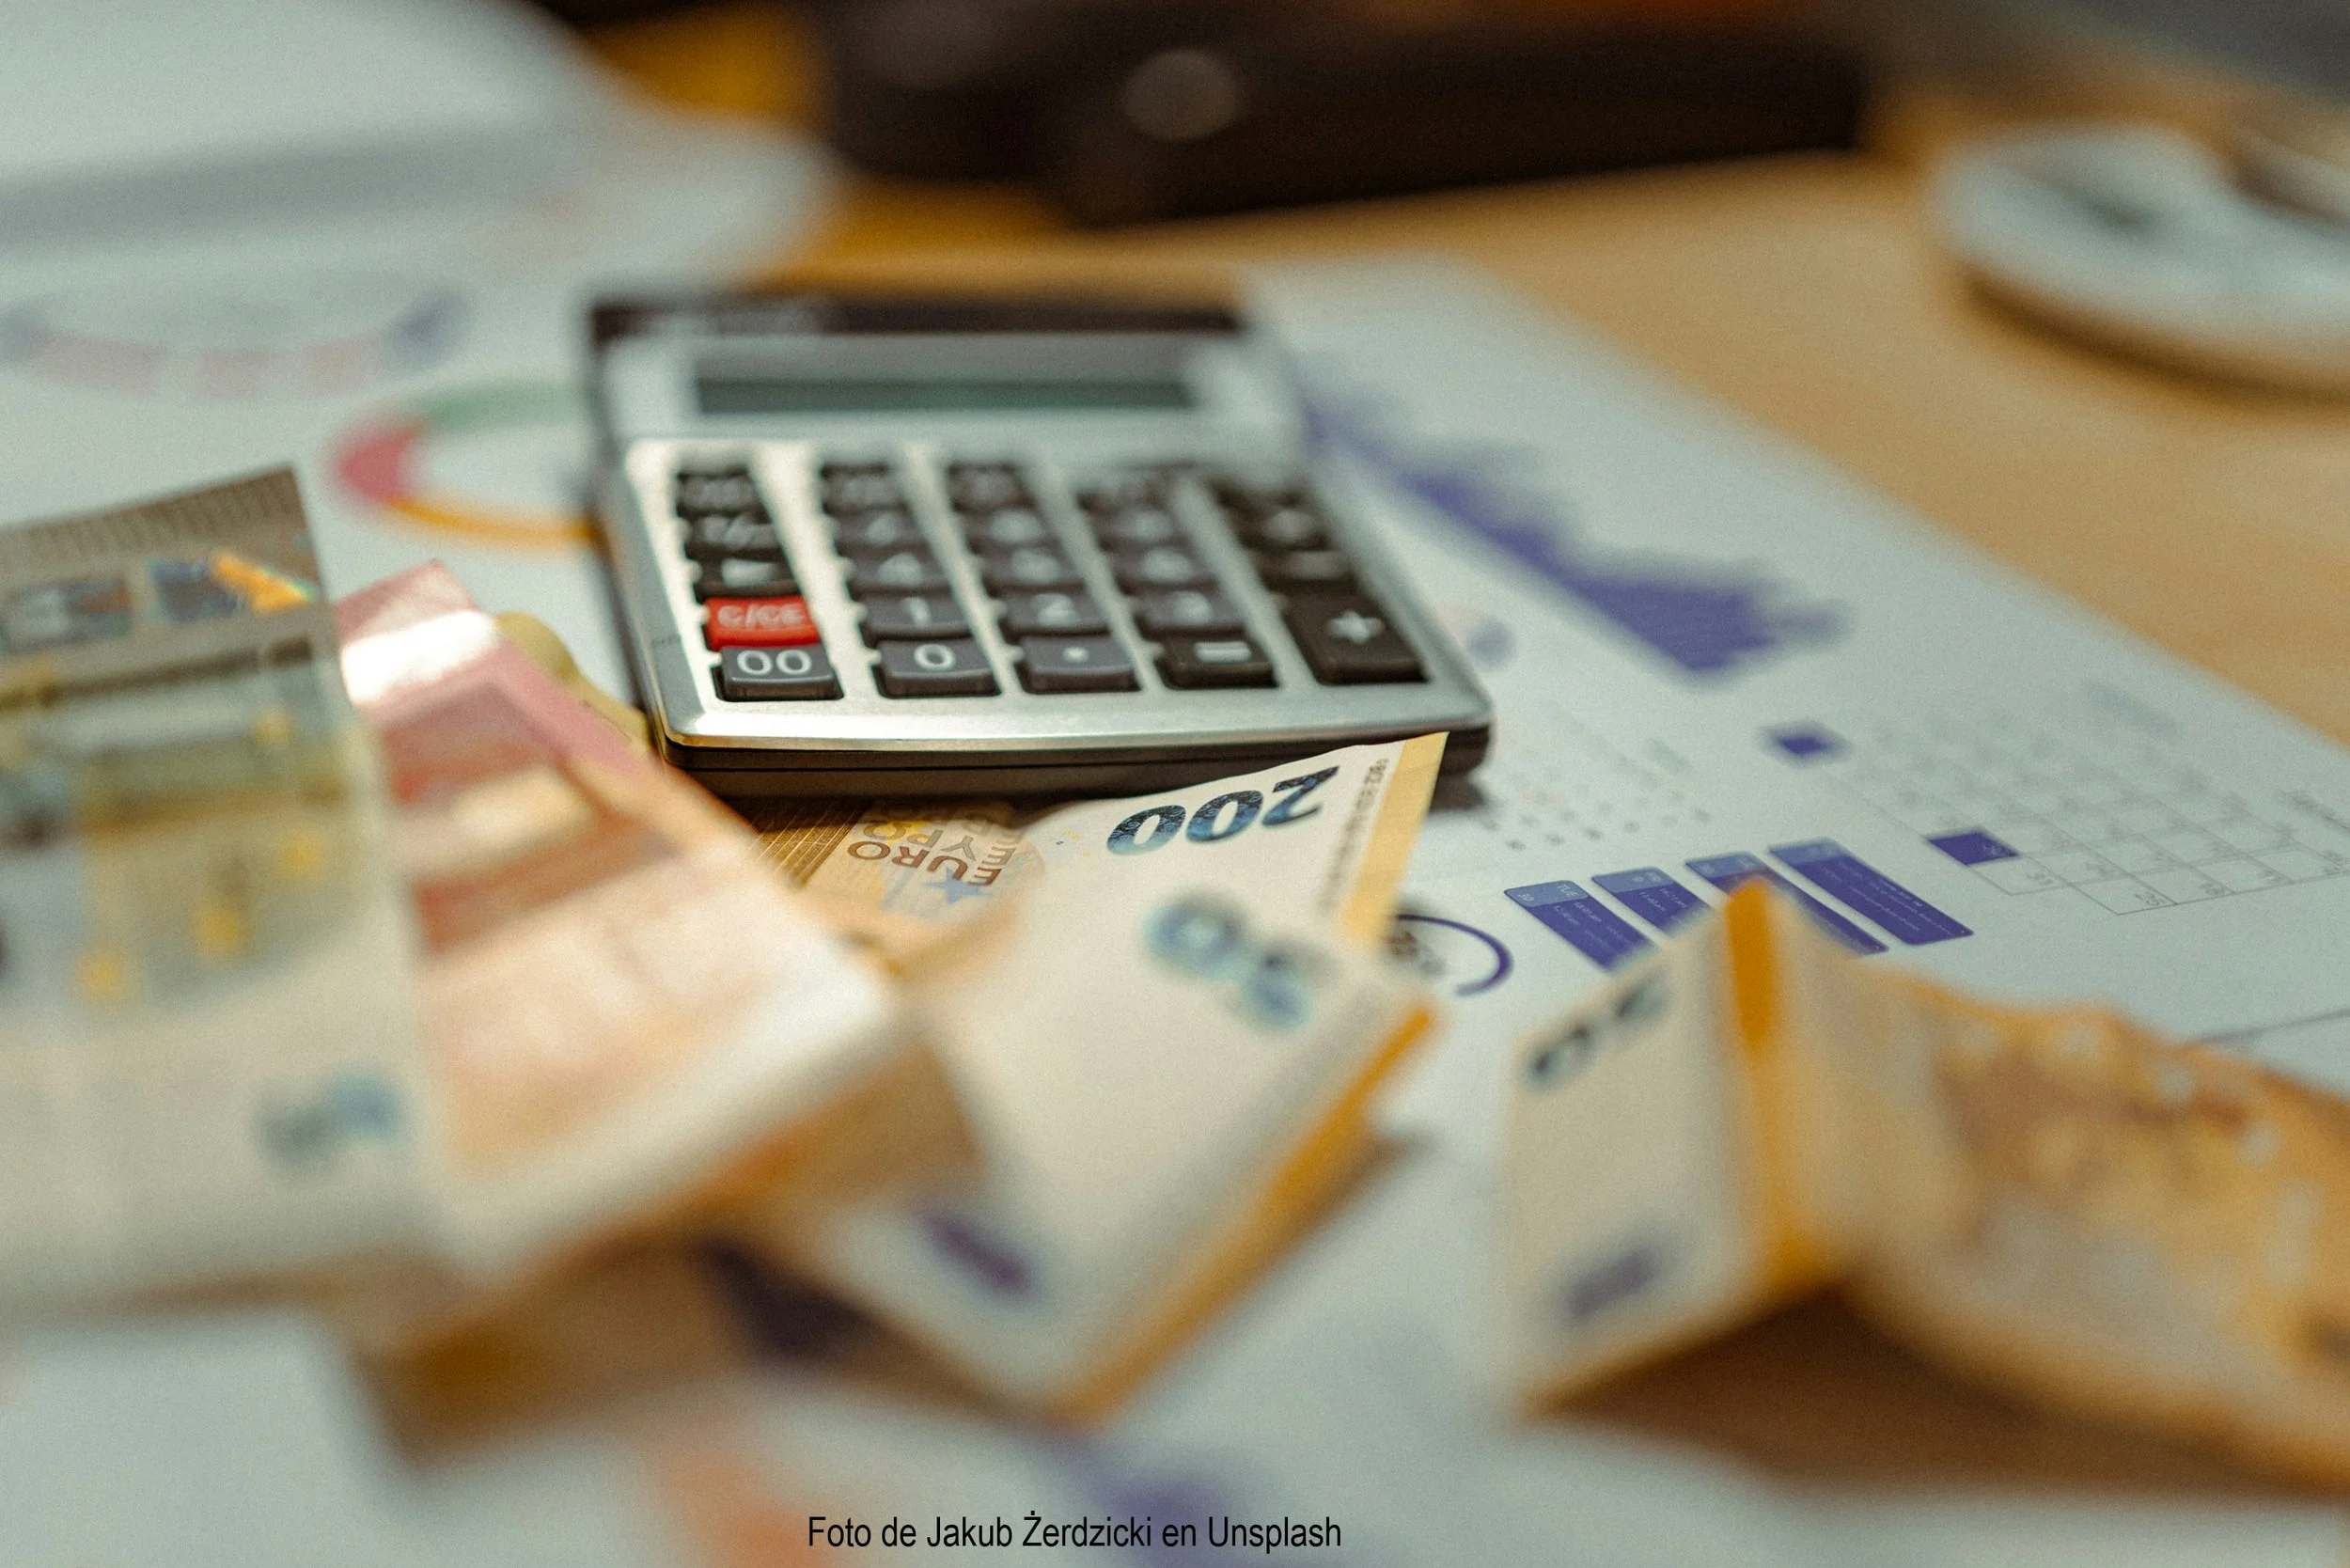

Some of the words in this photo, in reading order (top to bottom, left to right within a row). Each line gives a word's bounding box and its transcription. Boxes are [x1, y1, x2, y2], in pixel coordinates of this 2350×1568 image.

[717, 602, 806, 632] C/CE
[1034, 592, 1077, 628] 2
[737, 649, 812, 675] 00
[914, 644, 956, 671] 0
[1106, 764, 1340, 855] 200
[847, 840, 1003, 886] EURO
